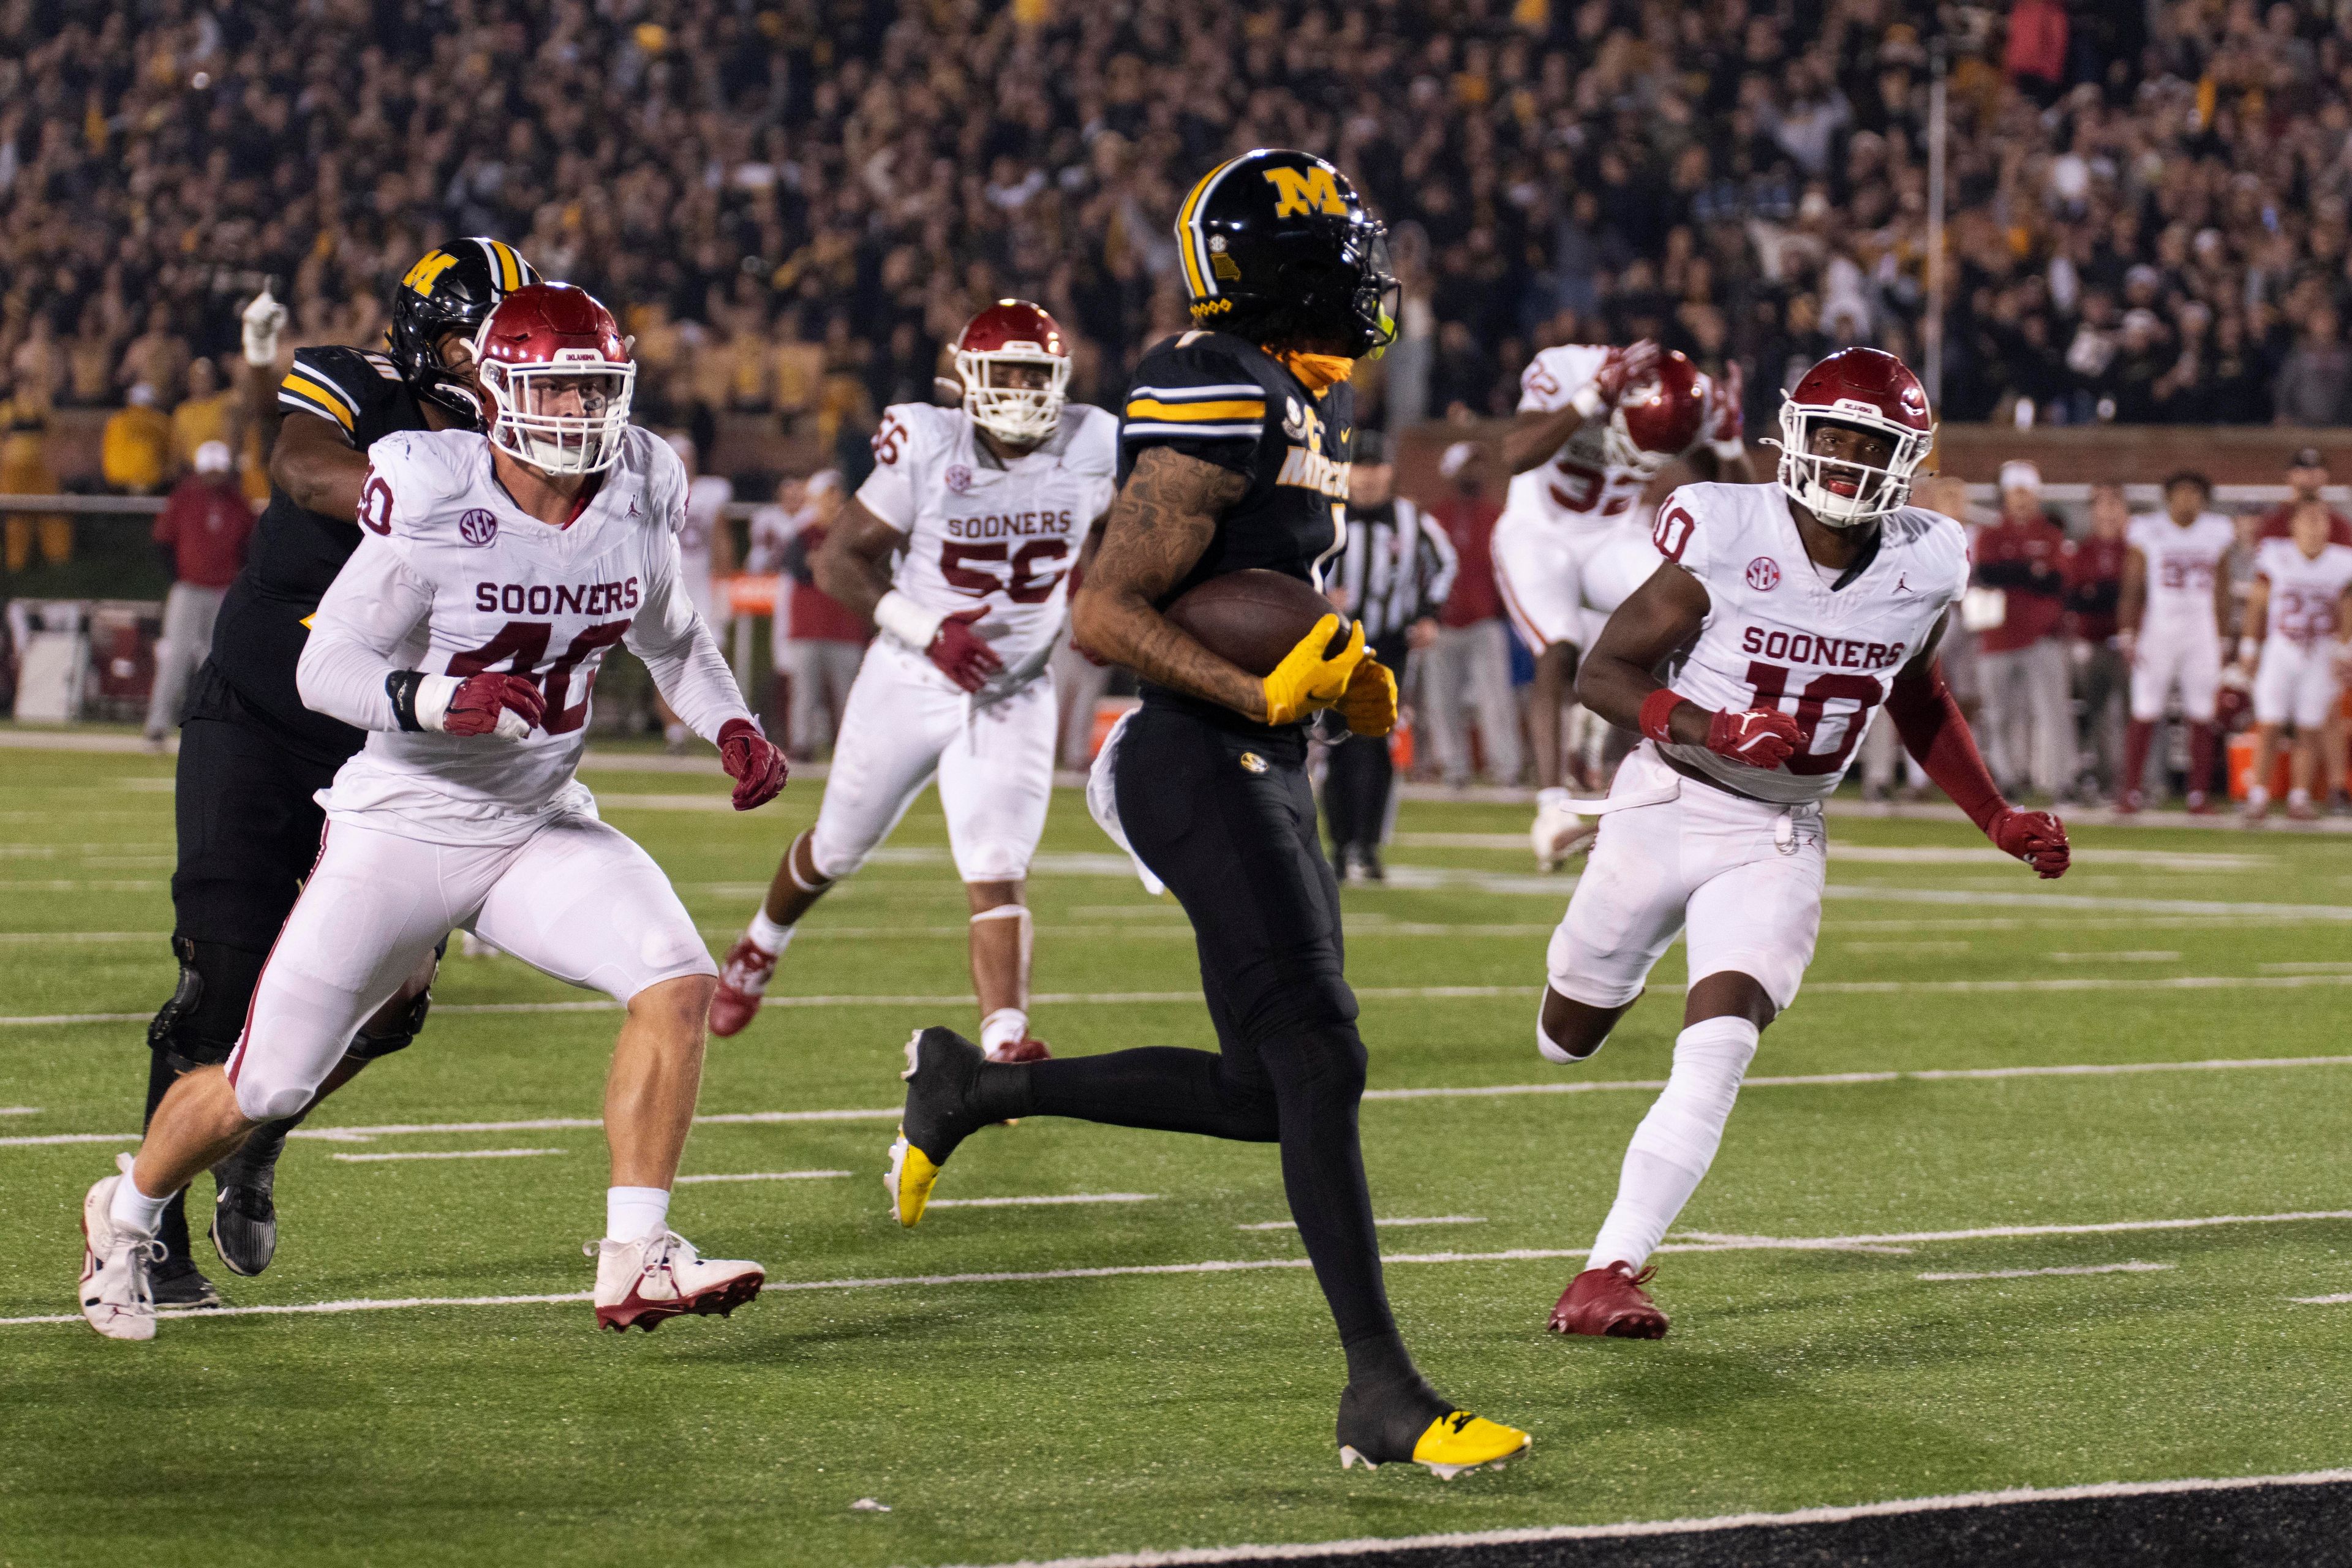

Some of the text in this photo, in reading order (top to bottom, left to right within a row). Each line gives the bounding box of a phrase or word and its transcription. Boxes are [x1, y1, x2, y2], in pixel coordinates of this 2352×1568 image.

[1263, 166, 1348, 217] M
[402, 249, 459, 297] M
[460, 509, 497, 545] SEC
[948, 510, 1071, 538] SOONERS
[940, 539, 1068, 603] 56
[1747, 557, 1779, 591] SEC
[476, 576, 638, 615] SOONERS
[1743, 626, 1905, 668] SOONERS
[1746, 661, 1884, 775] 10
